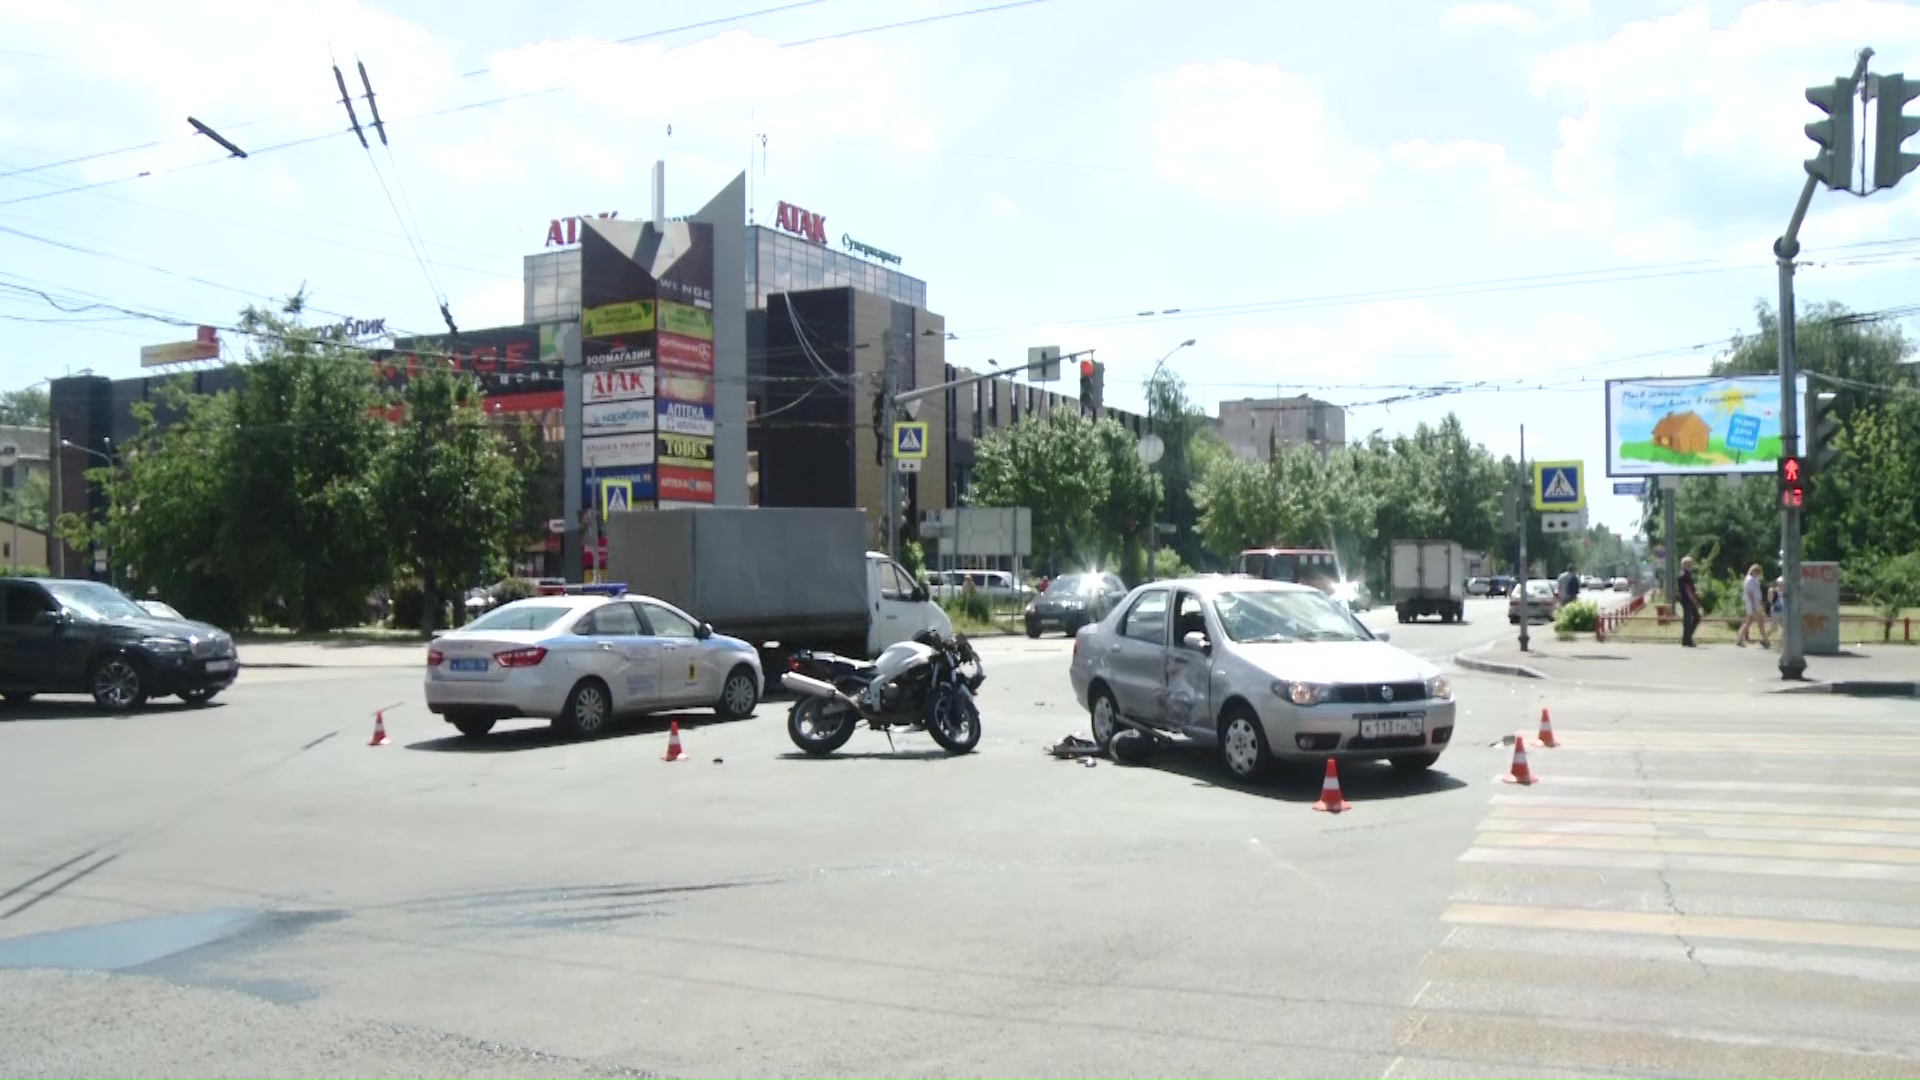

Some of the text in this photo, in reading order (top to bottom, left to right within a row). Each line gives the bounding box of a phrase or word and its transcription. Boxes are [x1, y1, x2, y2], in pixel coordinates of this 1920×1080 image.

[775, 200, 828, 244] АТАК
[586, 349, 651, 366] ЗООМАГАЗИН
[591, 371, 646, 398] АТАК
[667, 403, 705, 420] АПТЕКА
[665, 439, 707, 458] TODES
